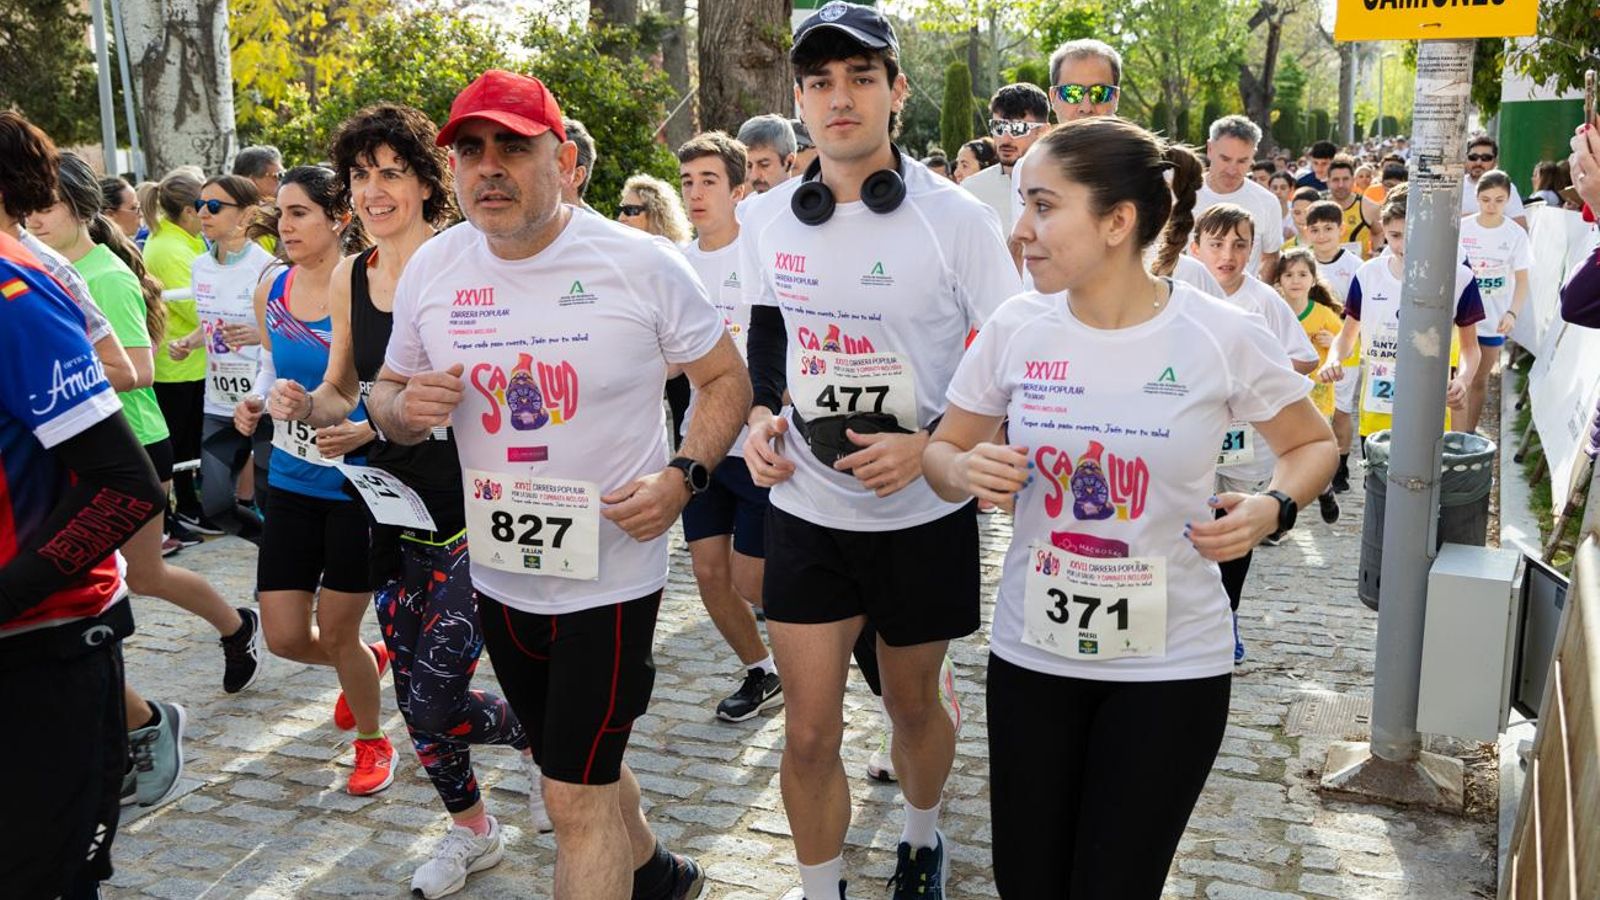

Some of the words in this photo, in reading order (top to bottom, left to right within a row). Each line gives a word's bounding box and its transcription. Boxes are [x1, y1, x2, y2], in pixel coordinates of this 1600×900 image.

[775, 252, 806, 273] XXVII
[1476, 277, 1503, 288] 255
[452, 287, 495, 306] XXVII
[450, 309, 478, 318] CARRERA
[479, 308, 510, 318] POPULAR
[571, 333, 589, 342] salud
[1023, 360, 1069, 380] XXVII
[213, 375, 252, 393] 1019
[1049, 385, 1085, 395] POPULAR
[1376, 380, 1394, 399] 2
[815, 384, 890, 412] 477
[1151, 429, 1170, 438] salud
[532, 483, 556, 493] CARRERA
[556, 485, 586, 495] POPULAR
[491, 510, 573, 549] 827
[1089, 563, 1117, 573] CARRERA
[1118, 563, 1149, 572] POPULAR
[1046, 588, 1128, 630] 371
